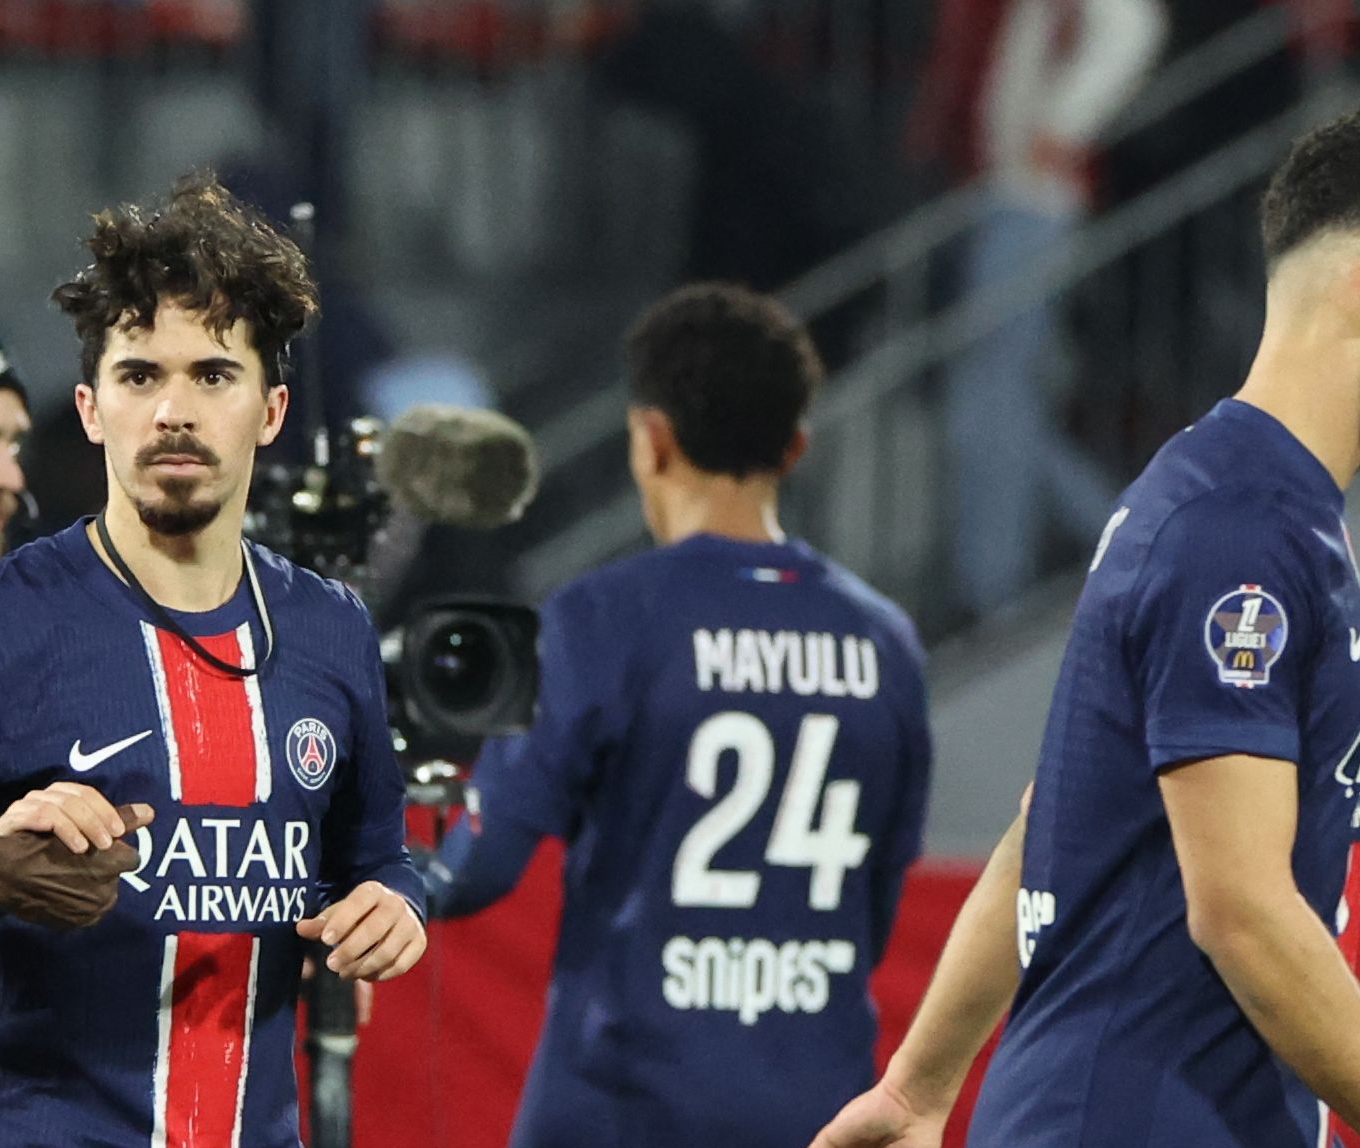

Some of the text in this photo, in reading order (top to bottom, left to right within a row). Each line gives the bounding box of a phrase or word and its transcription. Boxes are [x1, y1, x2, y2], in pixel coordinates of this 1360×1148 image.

[693, 628, 878, 699] MAYULU
[293, 722, 329, 740] PARIS
[671, 711, 870, 910] 24
[153, 884, 307, 922] AIRWAYS
